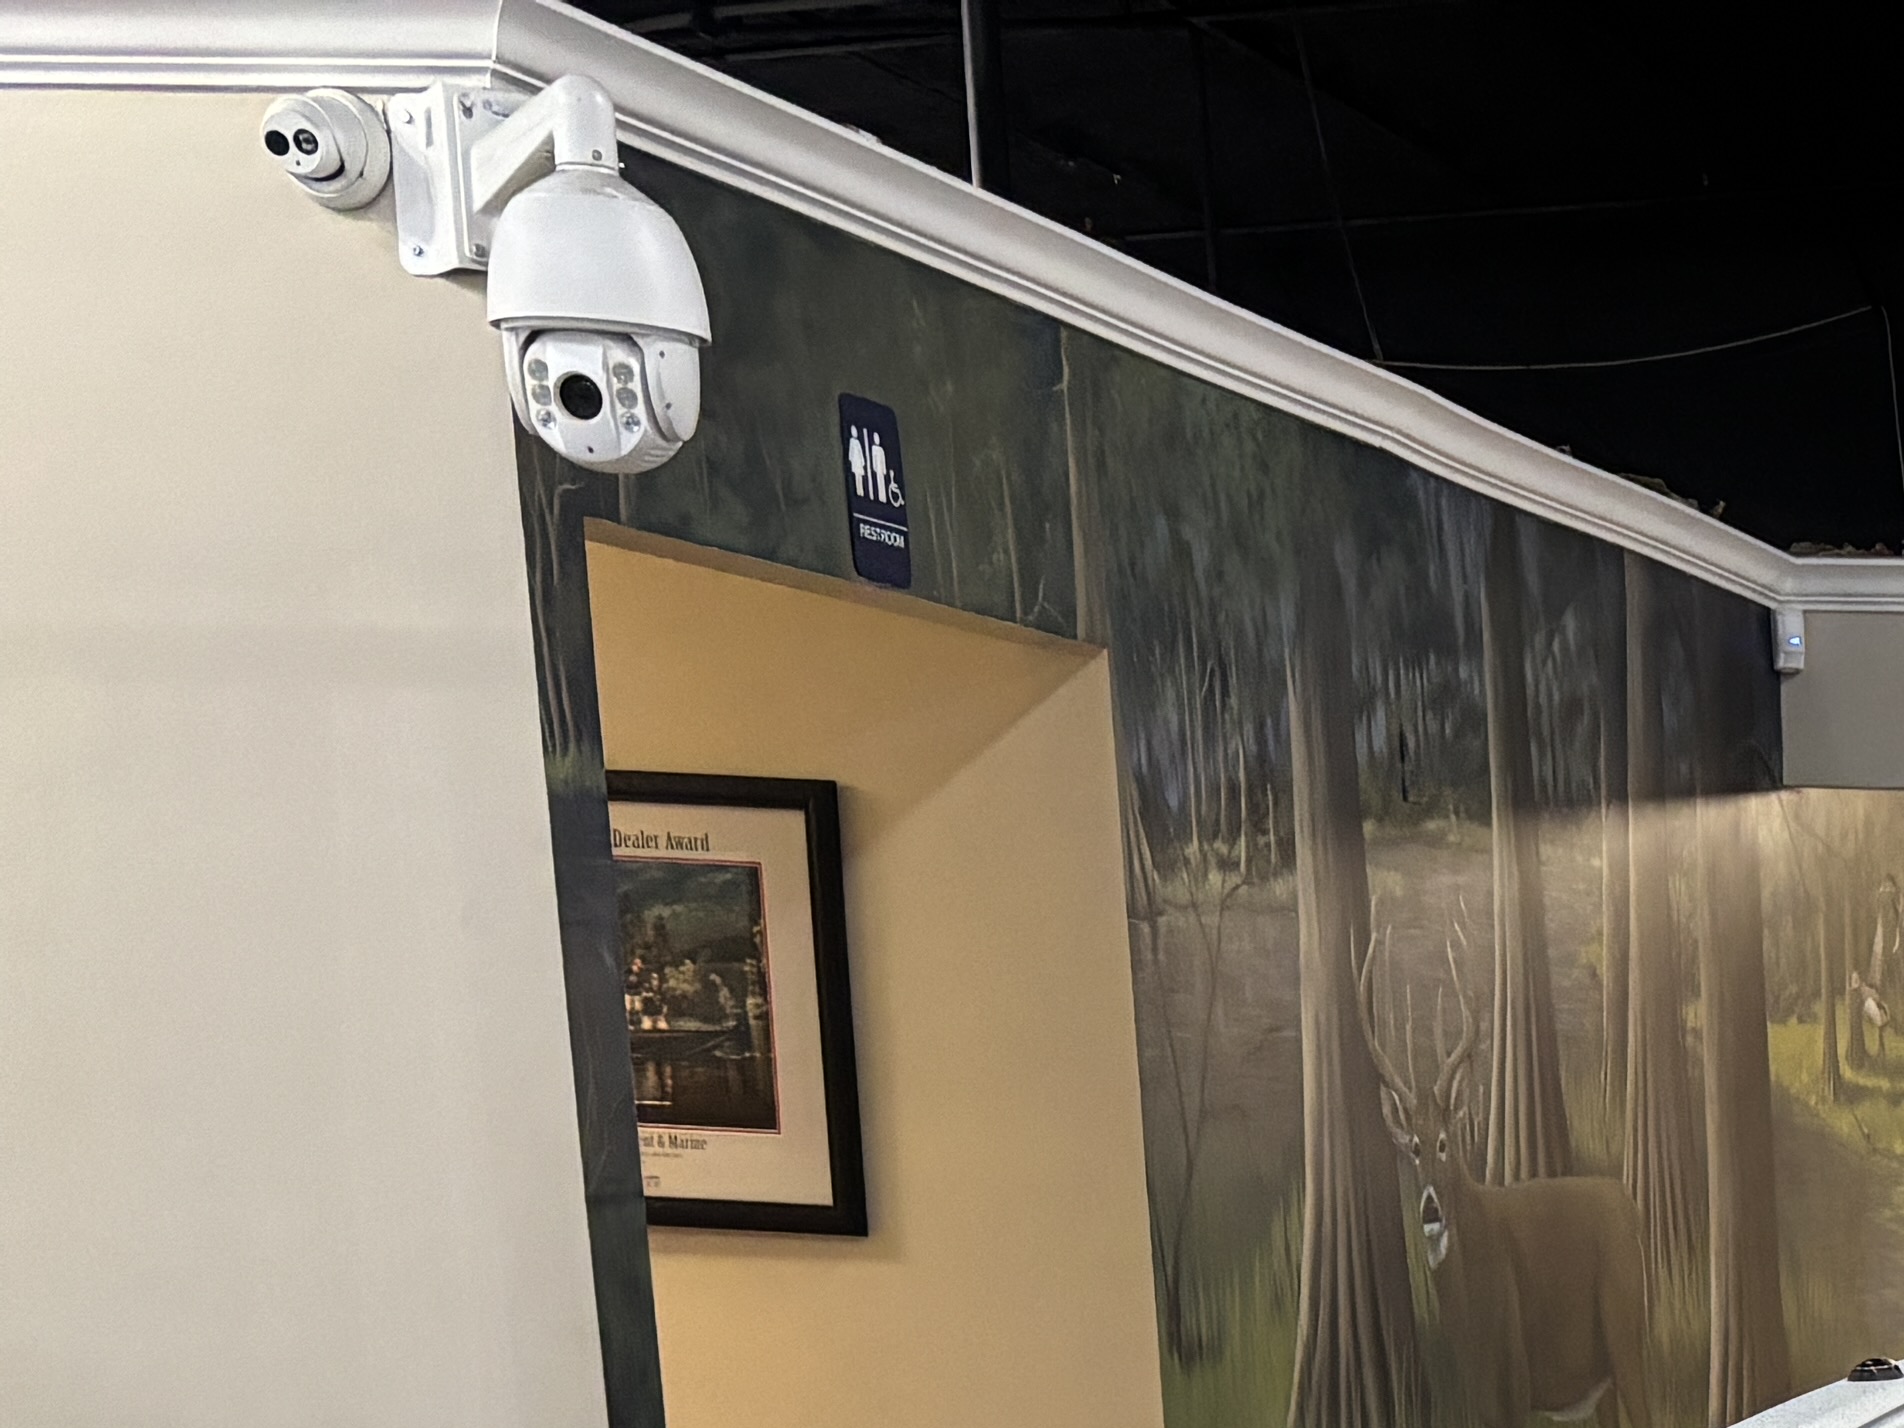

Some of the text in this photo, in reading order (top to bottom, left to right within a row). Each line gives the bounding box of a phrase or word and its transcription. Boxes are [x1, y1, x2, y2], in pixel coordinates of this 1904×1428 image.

[859, 523, 904, 548] RESTROOM
[613, 829, 710, 852] Dealer Award
